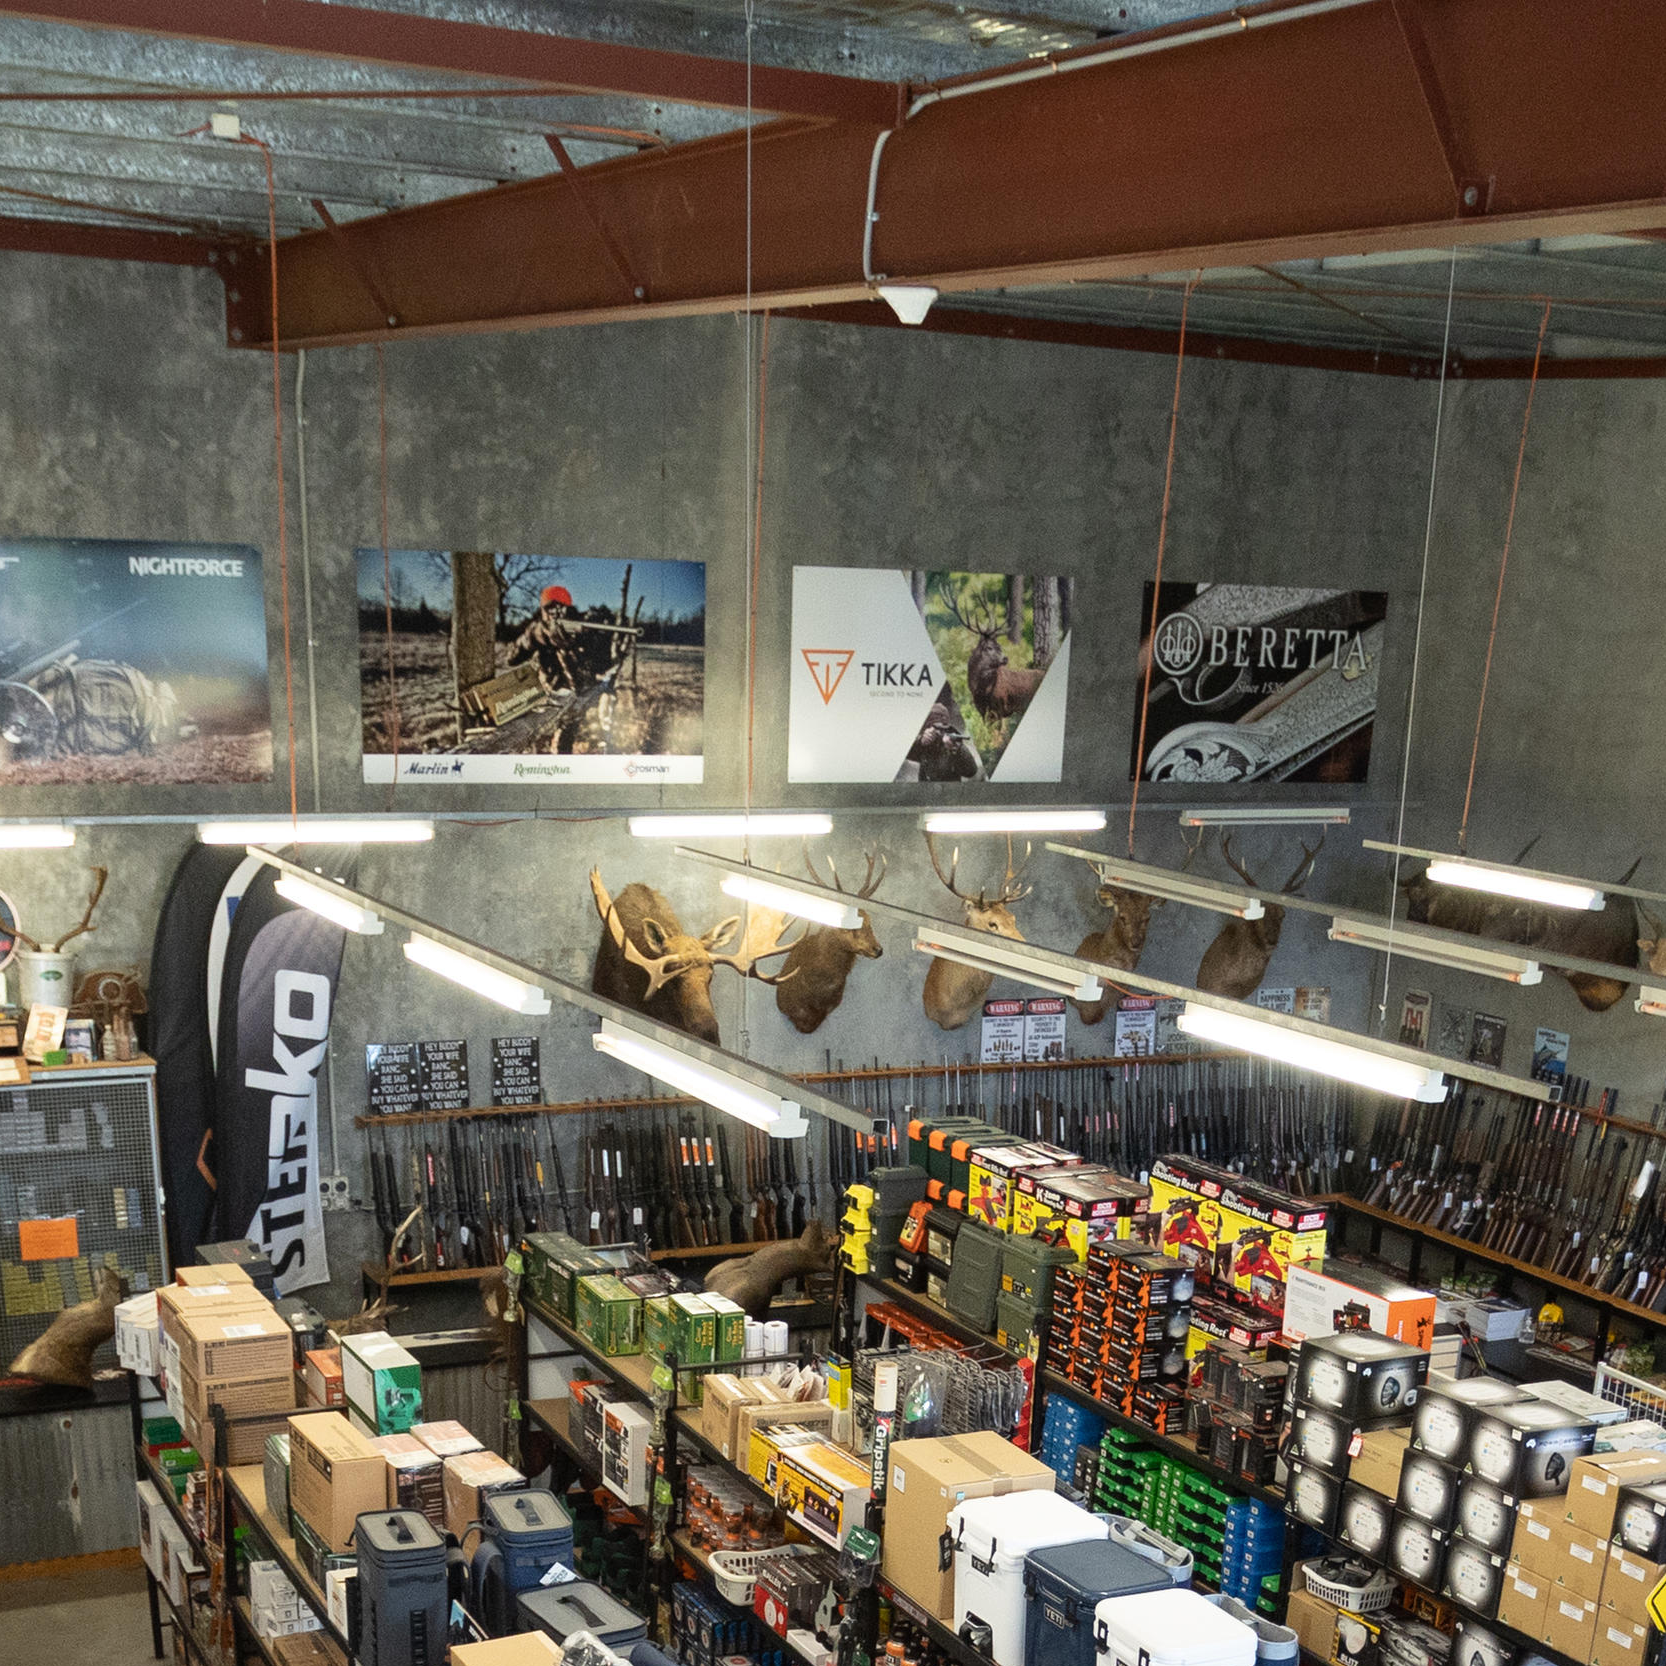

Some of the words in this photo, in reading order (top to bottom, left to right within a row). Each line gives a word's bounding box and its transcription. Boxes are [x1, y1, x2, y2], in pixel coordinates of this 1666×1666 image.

[129, 557, 244, 577] NIGHTFORCE
[1209, 626, 1367, 670] BERETTA
[861, 662, 933, 687] TIKKA
[404, 762, 449, 775] Marlin
[513, 762, 571, 776] Remington
[989, 1003, 1020, 1013] WARNING
[1031, 1001, 1061, 1011] WARNING
[1121, 998, 1153, 1010] WARNING
[425, 1043, 438, 1051] HEY
[439, 1042, 460, 1051] BUDDY
[498, 1039, 511, 1047] HEY
[512, 1038, 532, 1047] BUDDY
[426, 1052, 444, 1061] YOUR
[499, 1049, 516, 1058] YOUR
[430, 1082, 444, 1091] YOU
[445, 1081, 460, 1090] CAN
[502, 1078, 515, 1086] YOU
[516, 1077, 531, 1085] CAN
[394, 1084, 410, 1093] CAN
[507, 1085, 539, 1095] WHATEVER
[436, 1090, 469, 1100] WHATEVER
[429, 1101, 443, 1109] YOU
[501, 1096, 514, 1106] YOU
[1151, 1168, 1182, 1188] Shooting
[1181, 1176, 1198, 1192] Rest
[1221, 1198, 1251, 1217] Shooting
[1251, 1206, 1271, 1222] Rest
[1209, 1325, 1229, 1340] Rest
[205, 1341, 226, 1349] LEE
[874, 1424, 889, 1491] Gripstik
[1045, 1607, 1062, 1625] YETI
